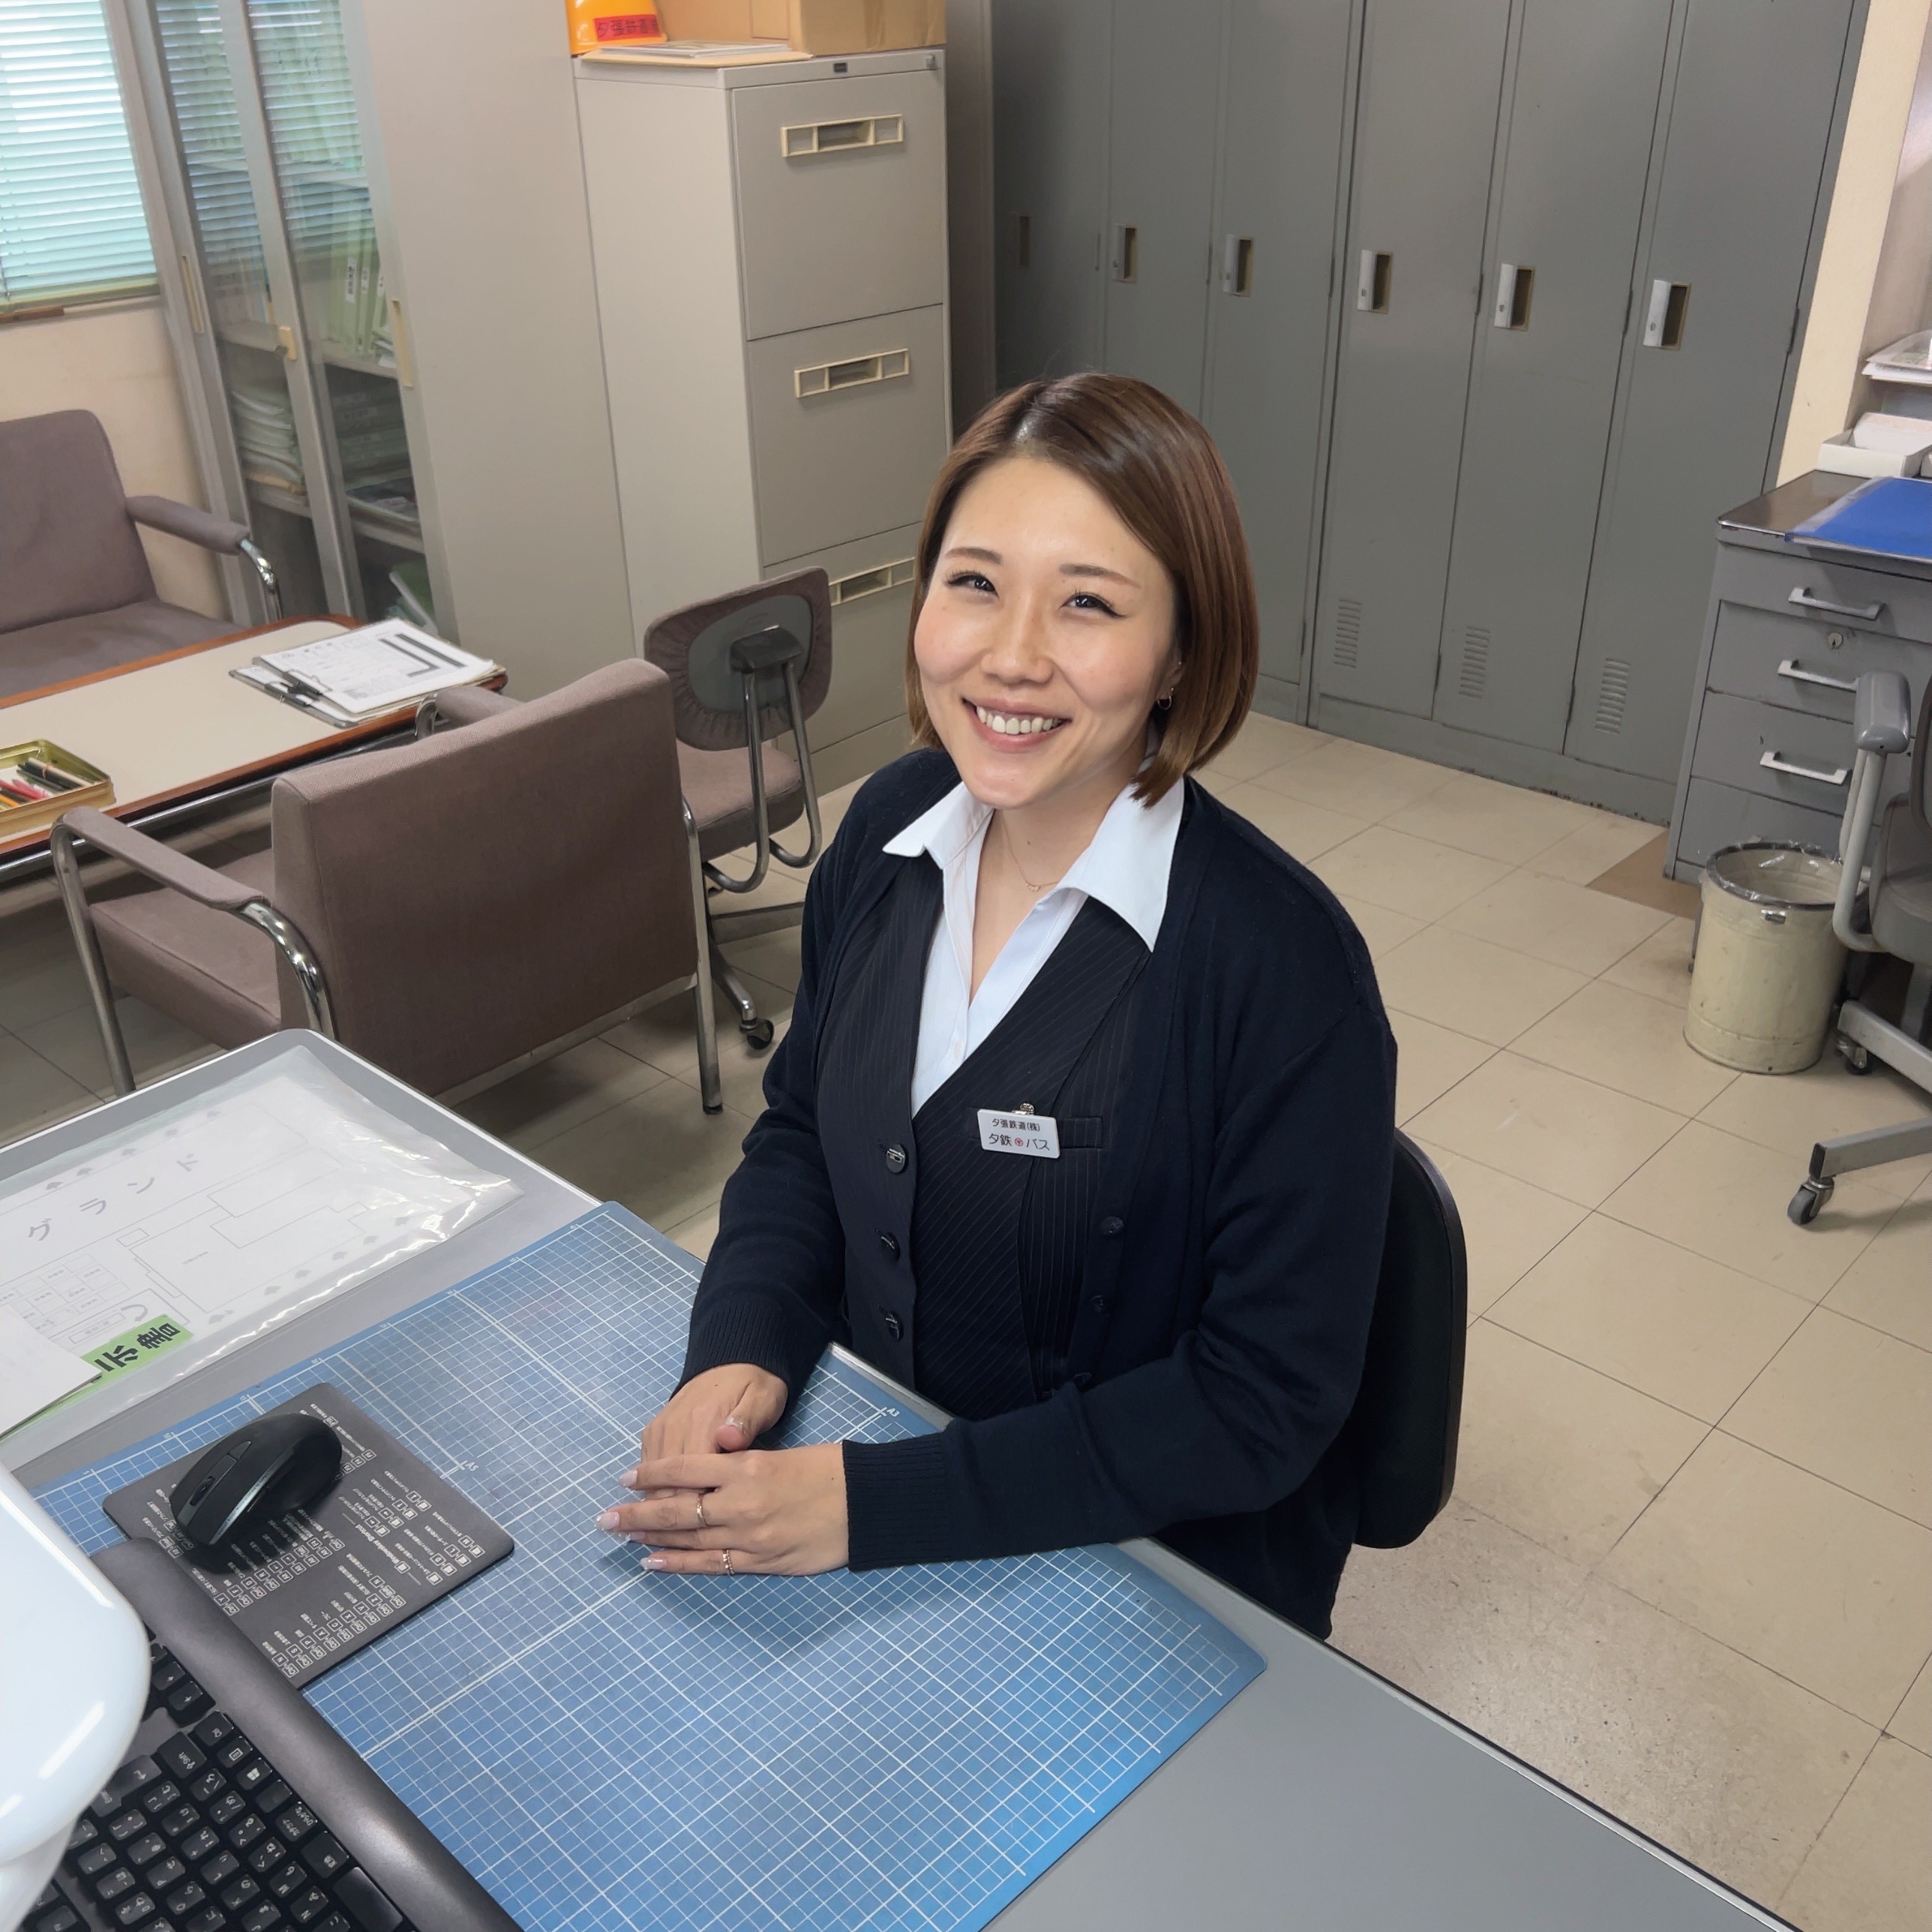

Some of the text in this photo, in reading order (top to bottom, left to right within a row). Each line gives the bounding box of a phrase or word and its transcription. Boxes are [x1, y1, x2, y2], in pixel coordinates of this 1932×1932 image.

[992, 1118, 1040, 1132] 夕張鉄道(株)
[886, 1407, 900, 1418] A3
[465, 1461, 479, 1472] A5
